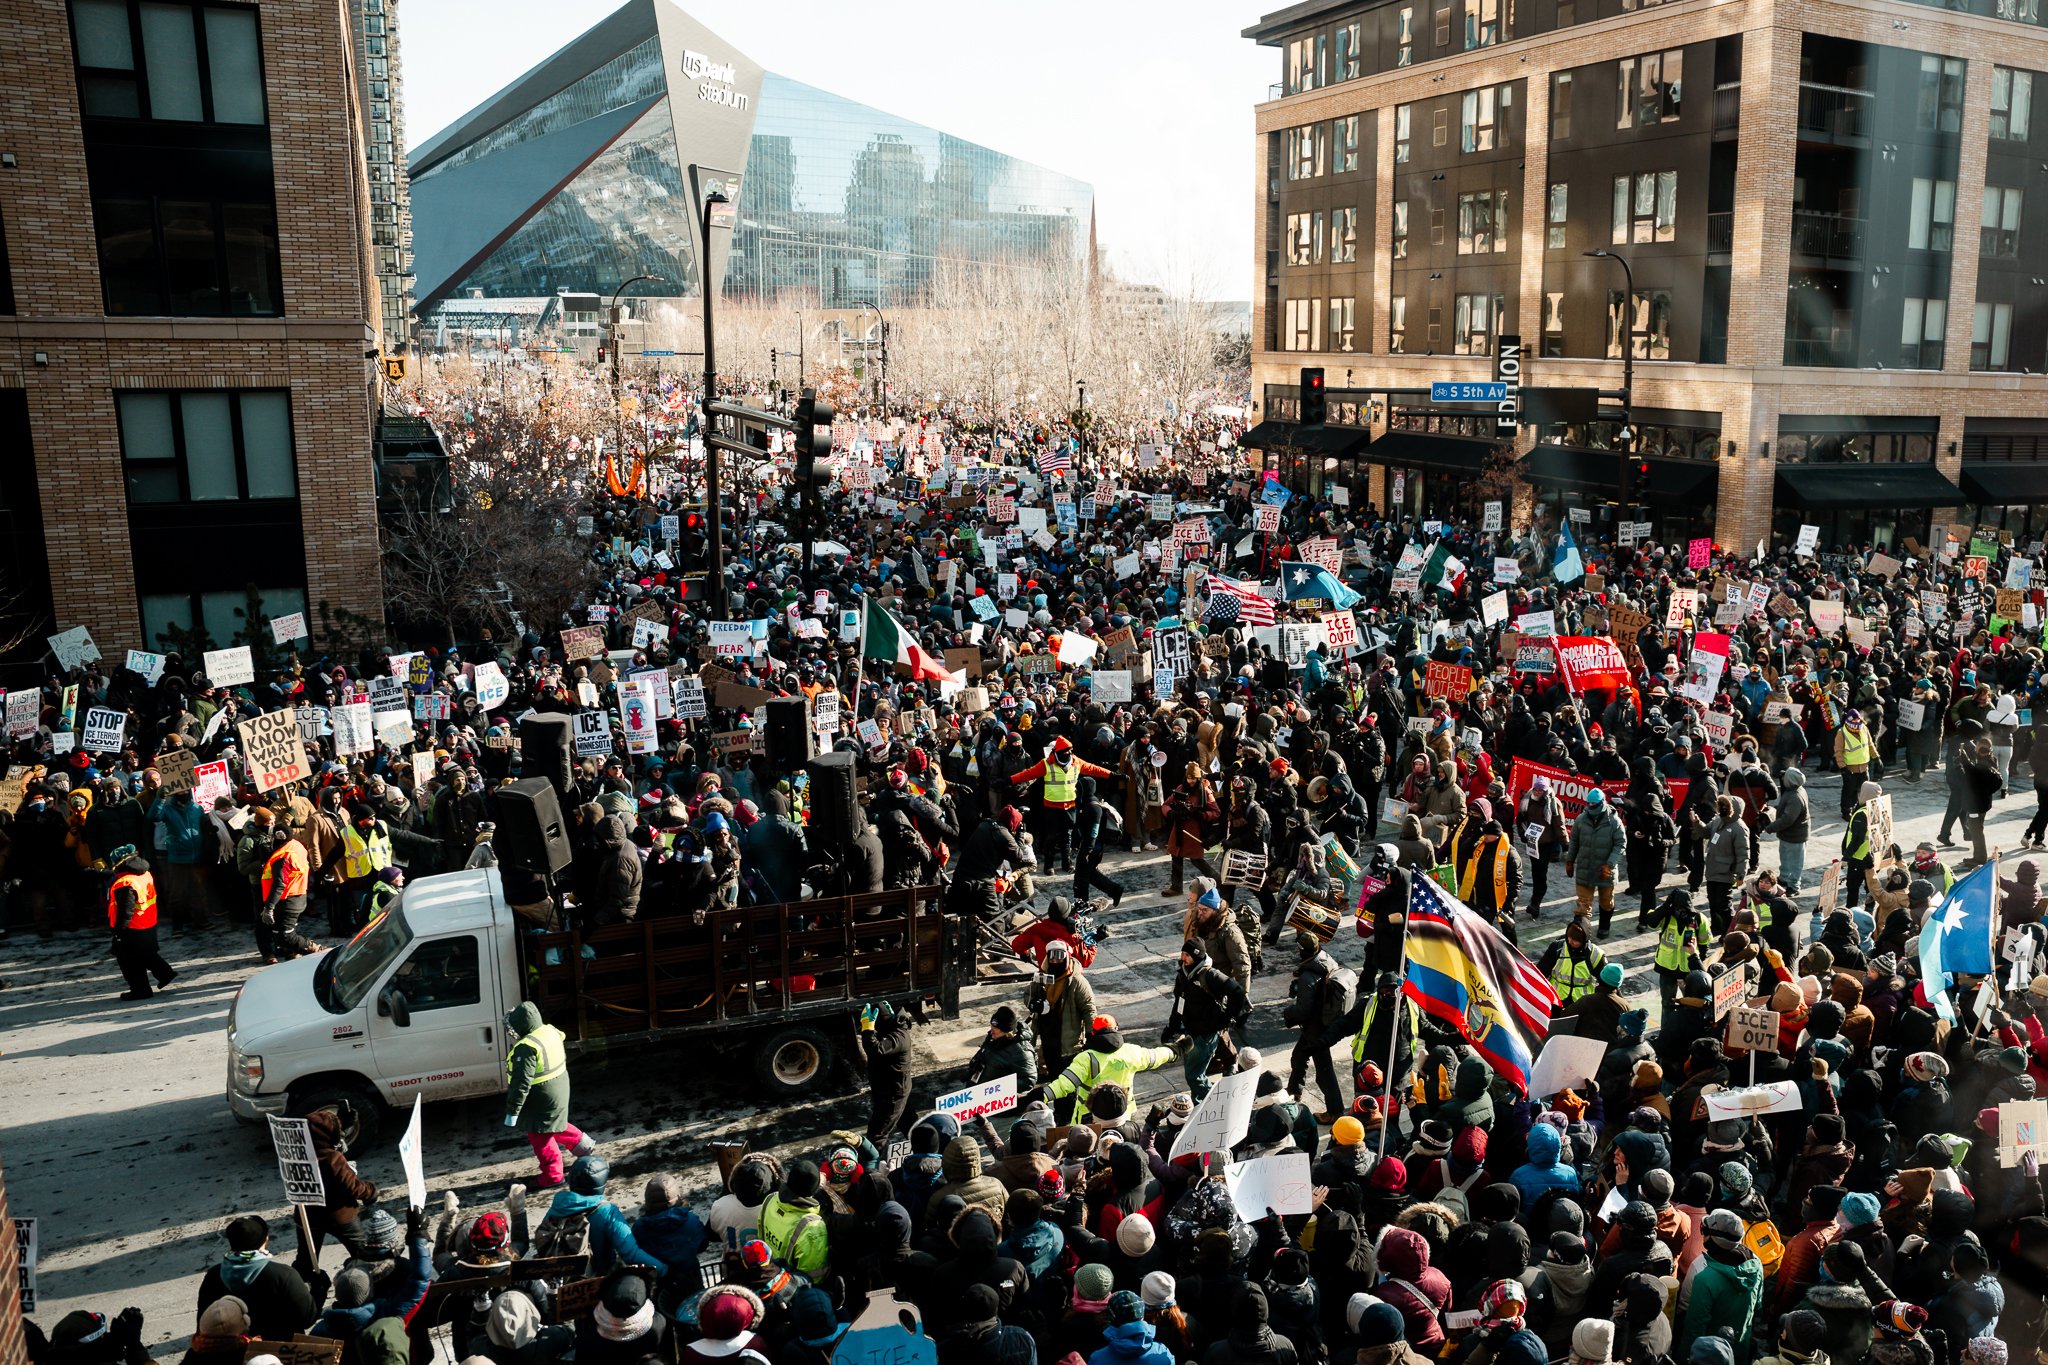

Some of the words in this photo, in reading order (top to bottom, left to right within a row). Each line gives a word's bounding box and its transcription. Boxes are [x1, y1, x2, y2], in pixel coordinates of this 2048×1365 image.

[698, 82, 748, 111] stadium
[1450, 386, 1459, 398] S
[1463, 386, 1484, 398] 5th
[1488, 386, 1504, 398] Av
[1098, 486, 1112, 494] ICE
[1486, 504, 1500, 512] BEGIN
[999, 512, 1013, 520] OUT!
[1262, 512, 1277, 520] ICE
[1487, 513, 1499, 521] ONE
[1260, 522, 1277, 530] OUT!
[1175, 529, 1192, 539] ICE
[1690, 540, 1708, 548] ICE
[1162, 559, 1173, 567] OUT!
[1672, 599, 1692, 610] ICE
[1999, 603, 2021, 612] COLD
[637, 618, 648, 628] ICE
[649, 622, 661, 630] OUT
[1608, 608, 1646, 628] FEELS
[713, 623, 751, 632] FREEDOM
[1326, 618, 1351, 631] ICE
[562, 627, 601, 644] JESUS
[1108, 630, 1129, 647] STOP
[1329, 630, 1354, 644] OUT!
[1609, 625, 1636, 643] LIKE
[718, 644, 744, 654] FEAR
[411, 656, 431, 671] ICE
[409, 673, 429, 685] OUT
[1428, 663, 1470, 685] PEOPLE
[371, 689, 391, 699] JUSTICE
[392, 687, 403, 695] FOR
[694, 689, 703, 697] FOR
[1426, 680, 1447, 696] NOT
[479, 687, 503, 702] ICE
[818, 696, 838, 704] GENERAL
[392, 702, 407, 711] GOOD
[416, 696, 449, 707] FUCK
[416, 708, 446, 719] ICE!
[691, 704, 704, 712] GOOD
[818, 705, 837, 713] STRIKE
[87, 711, 123, 730] STOP
[296, 709, 320, 721] ICE
[1711, 713, 1725, 726] ICE
[244, 712, 286, 735] YOU
[579, 712, 603, 733] ICE
[818, 721, 838, 731] JUSTICE
[1412, 721, 1427, 730] ICE
[86, 730, 96, 738] ICE
[97, 731, 121, 740] TERROR
[862, 725, 874, 735] ICE
[1704, 723, 1727, 737] GTFO
[84, 738, 119, 746] NOW!
[246, 724, 296, 752] KNOW
[713, 736, 730, 747] ICE
[731, 735, 750, 745] OUT
[864, 734, 878, 743] OUT
[252, 739, 296, 763] WHAT
[577, 740, 611, 750] MINNESOTA
[160, 751, 190, 766] ICE
[260, 753, 295, 773] YOU
[161, 764, 183, 775] OUT
[181, 769, 194, 777] OF
[263, 764, 300, 788] DID
[169, 776, 195, 793] MN
[1496, 859, 1505, 879] LOVE
[1723, 971, 1737, 988] ICE
[1715, 979, 1743, 1003] MURDERS
[1738, 1012, 1769, 1029] ICE
[333, 1025, 353, 1034] 2802
[1743, 1031, 1776, 1049] OUT
[390, 1077, 423, 1088] USDOT
[426, 1071, 465, 1082] 1093909
[938, 1091, 973, 1110] HONK
[984, 1084, 1001, 1096] FOR
[953, 1095, 1016, 1122] DEMOCRACY
[1199, 1105, 1225, 1122] not
[291, 1146, 308, 1161] FOR
[561, 1283, 596, 1297] HATE
